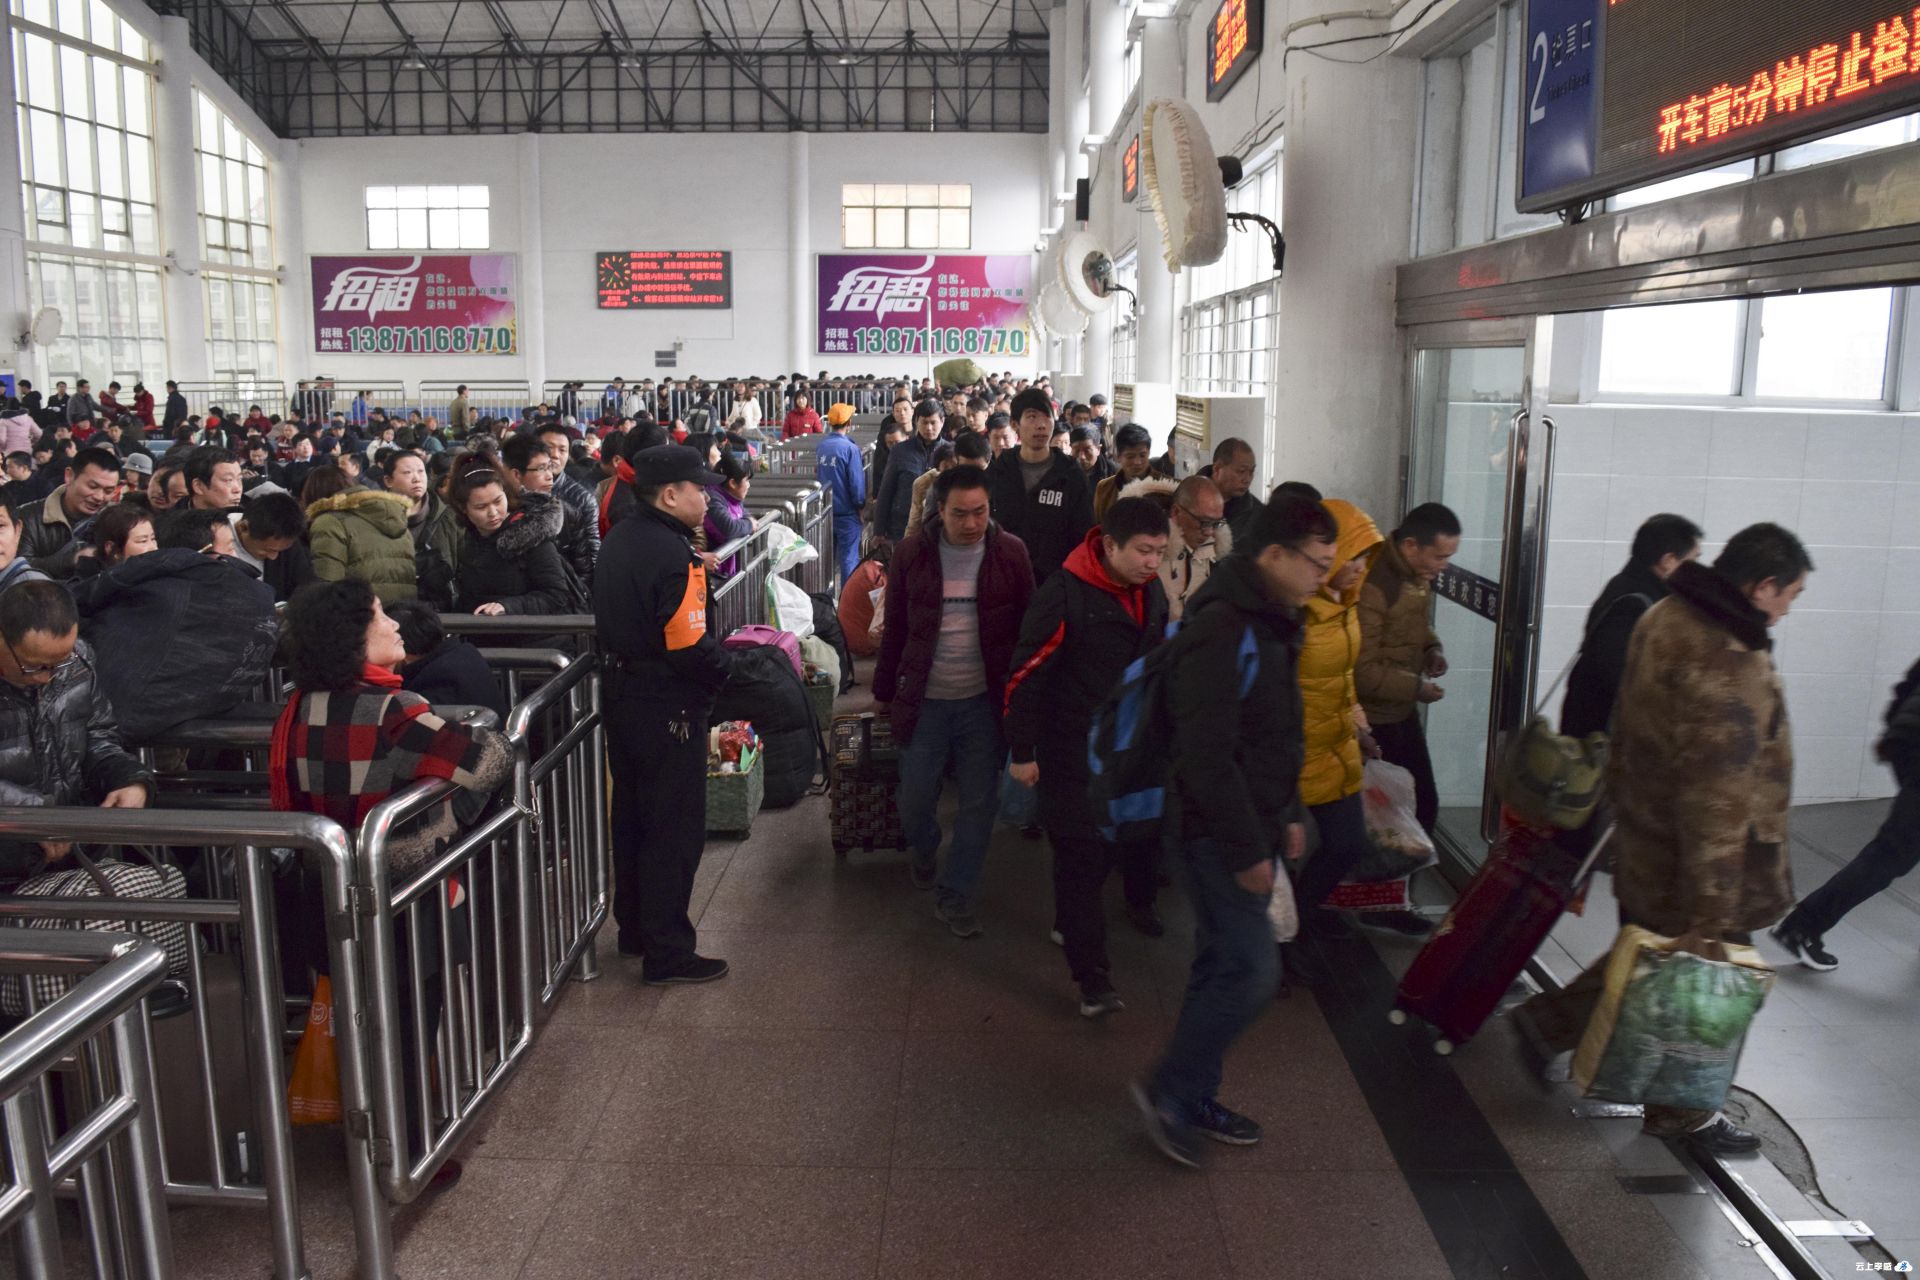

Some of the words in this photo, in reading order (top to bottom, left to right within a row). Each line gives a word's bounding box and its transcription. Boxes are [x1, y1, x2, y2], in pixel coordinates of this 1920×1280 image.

[1551, 20, 1592, 68] 检票口
[1530, 31, 1548, 124] 2
[1658, 10, 1920, 153] 开车前5分钟停止检
[321, 257, 422, 322] 招租
[826, 256, 935, 324] 招租
[320, 327, 343, 338] 招租
[347, 326, 511, 352] 13871168770
[825, 328, 849, 339] 招租
[853, 327, 1026, 353] 13871168770
[1038, 488, 1063, 507] GDR
